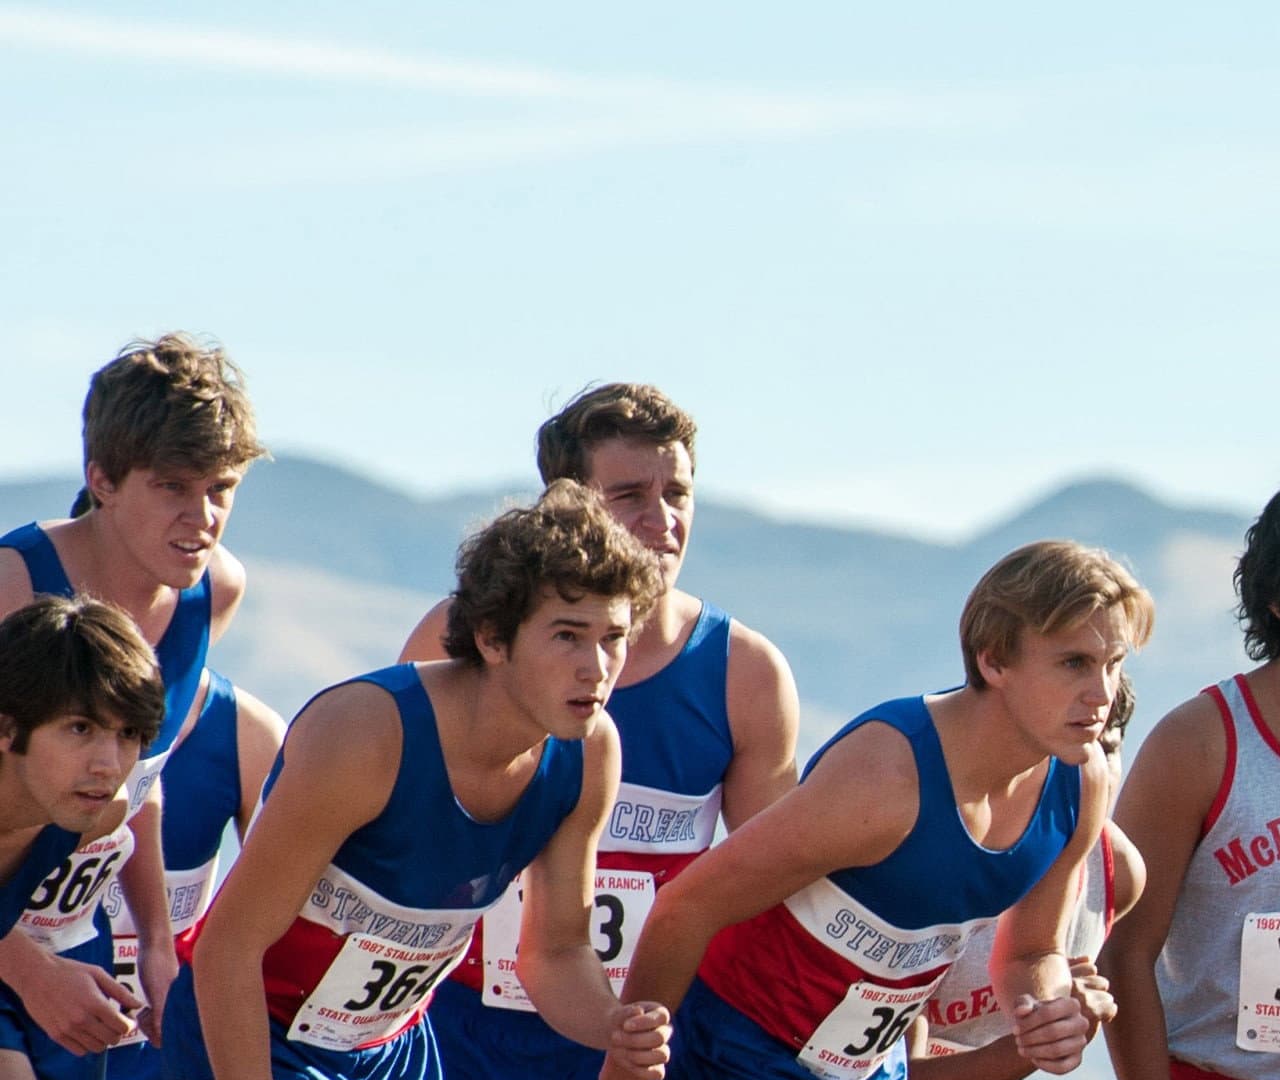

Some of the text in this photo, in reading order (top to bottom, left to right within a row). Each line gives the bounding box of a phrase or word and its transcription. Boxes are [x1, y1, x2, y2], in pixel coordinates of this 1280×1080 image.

[608, 876, 645, 890] RANCH
[311, 878, 451, 948] STEVENS
[357, 938, 385, 957] 1987
[384, 946, 432, 962] STALLION
[606, 967, 629, 979] MEE
[860, 988, 886, 1002] 1987
[317, 1007, 352, 1024] STATE
[844, 1002, 921, 1057] 36
[818, 1048, 850, 1068] STATE
